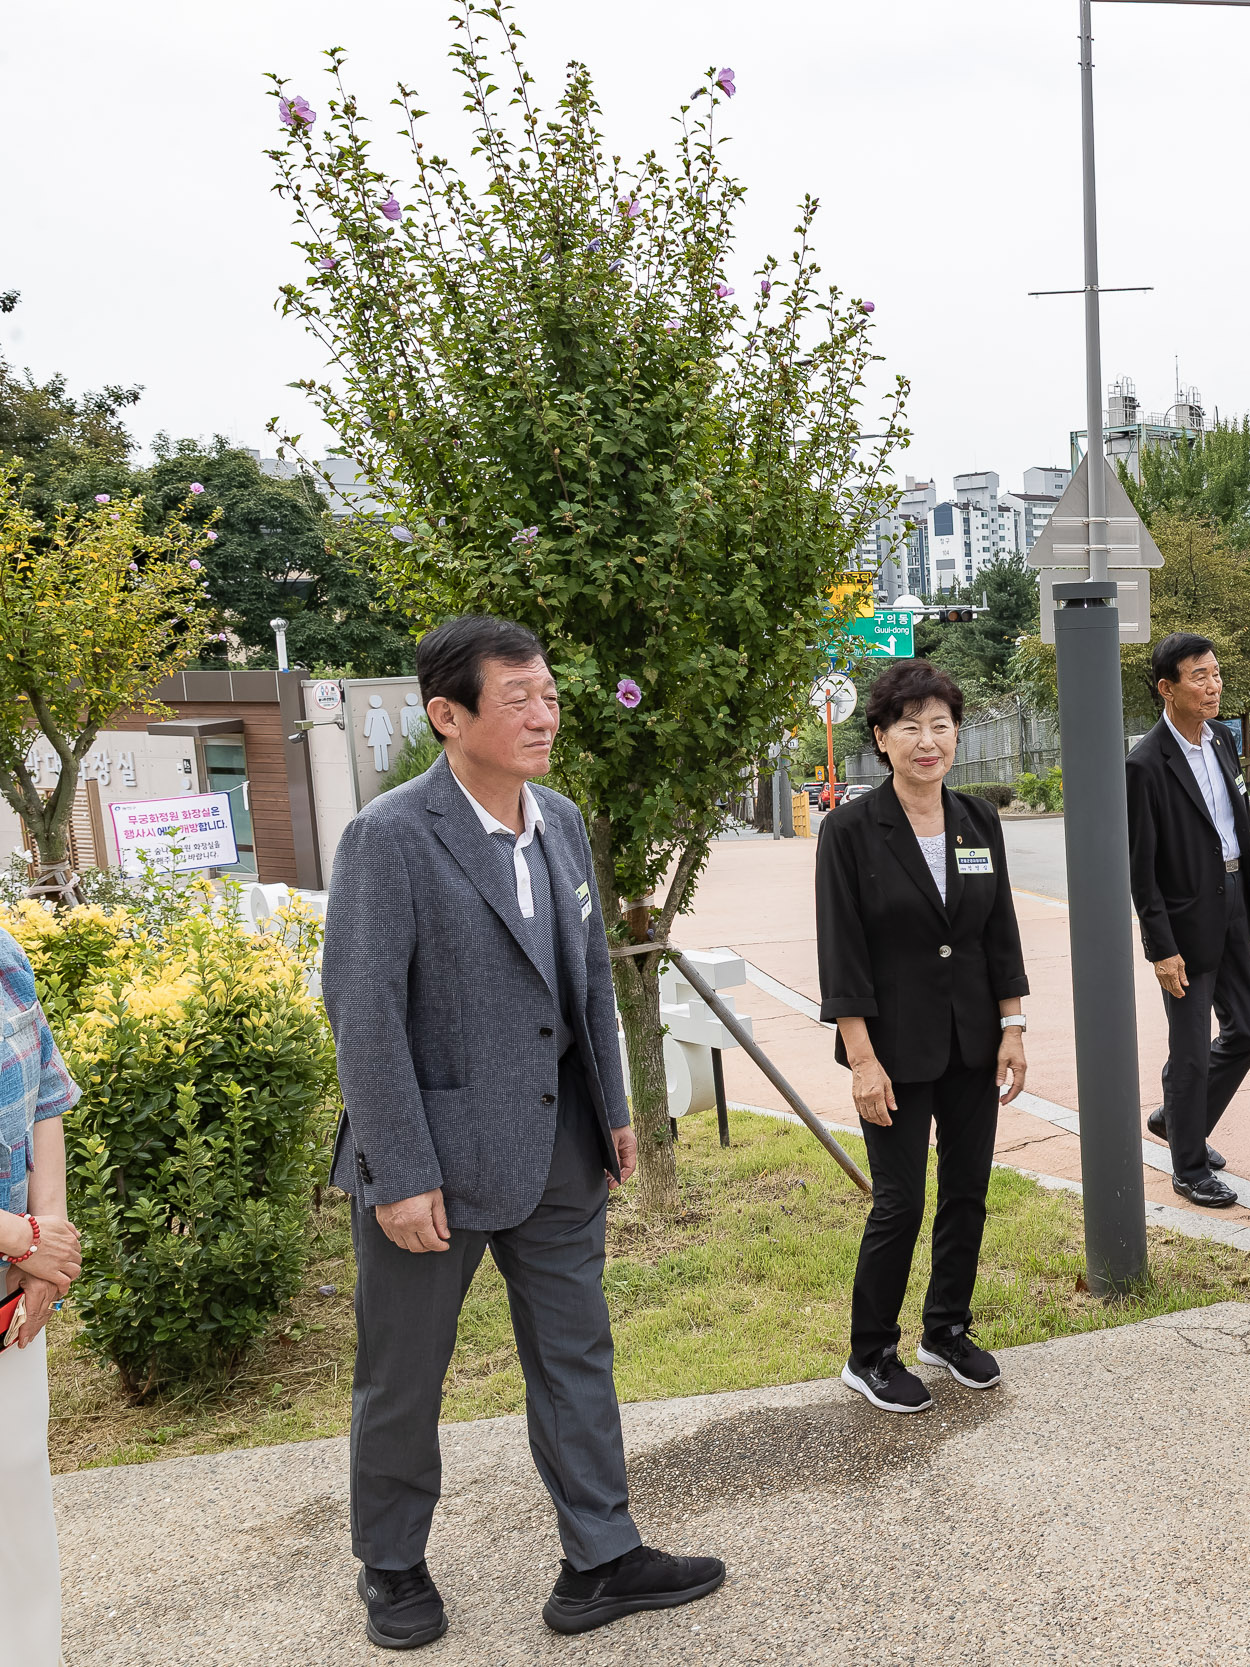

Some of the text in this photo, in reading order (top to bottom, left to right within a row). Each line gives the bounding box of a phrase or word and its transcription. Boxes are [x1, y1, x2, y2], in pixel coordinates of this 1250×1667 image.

[873, 613, 909, 625] 구의동
[874, 626, 910, 636] Guui-dong
[128, 806, 220, 825] 무궁화정원 화장실은
